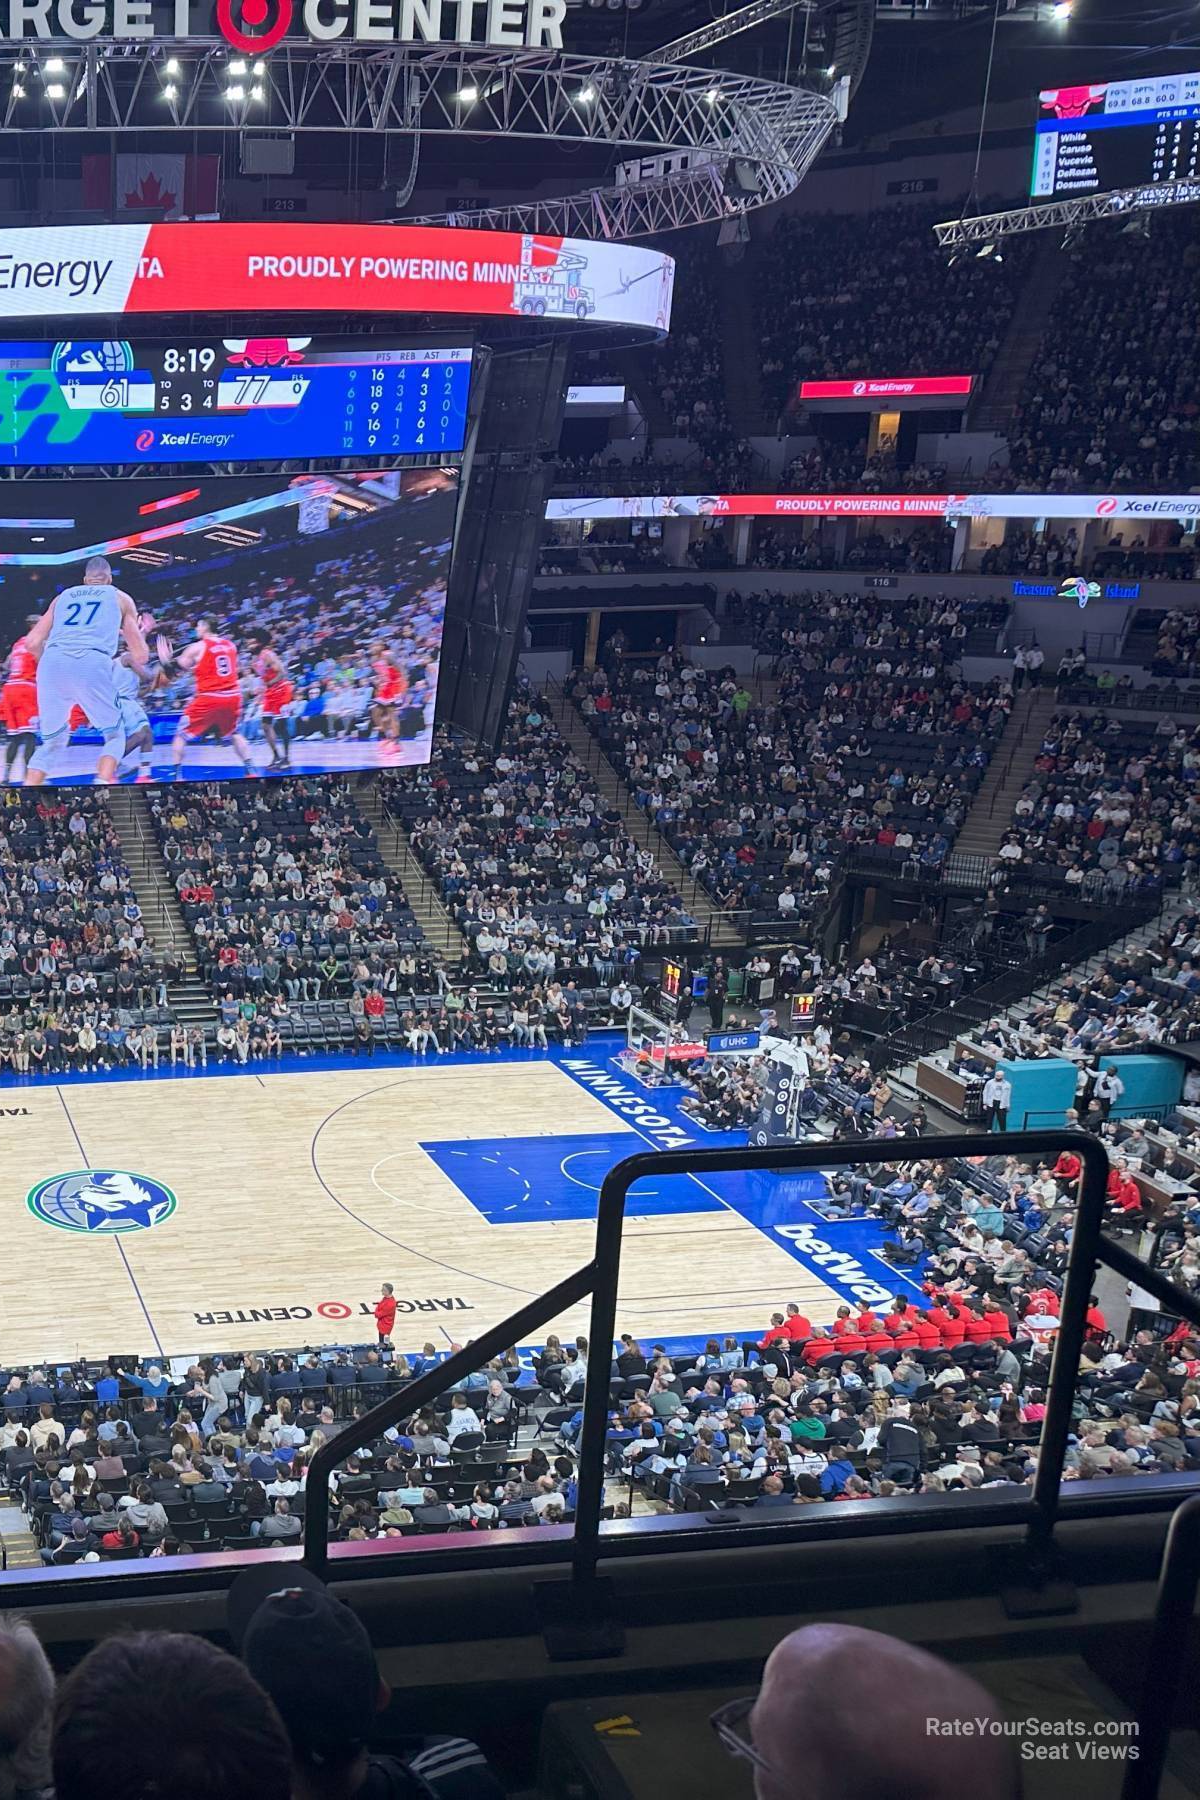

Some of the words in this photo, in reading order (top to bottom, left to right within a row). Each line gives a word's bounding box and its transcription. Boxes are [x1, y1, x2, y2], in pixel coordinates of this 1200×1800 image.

[304, 0, 566, 49] CENTER
[1175, 121, 1181, 130] 4
[1059, 144, 1092, 154] Caruso
[1174, 133, 1180, 142] 3
[1193, 132, 1199, 140] 3
[1172, 145, 1178, 155] 4
[1191, 144, 1198, 153] 4
[1057, 168, 1097, 178] DeRozan
[1190, 156, 1196, 165] 6
[1056, 179, 1099, 190] Dosunmu
[1169, 170, 1176, 179] 2
[248, 256, 356, 278] PROUDLY
[360, 257, 468, 281] POWERING
[163, 348, 215, 373] 8:19
[376, 353, 391, 361] PTS
[400, 352, 415, 360] REB
[424, 351, 440, 360] AST
[451, 350, 461, 359] PF
[349, 370, 357, 381] 9
[372, 369, 384, 381] 16
[398, 368, 405, 379] 4
[422, 367, 430, 379] 4
[445, 366, 453, 378] 0
[160, 381, 171, 389] TO
[203, 380, 214, 388] TO
[234, 375, 271, 405] 77
[347, 388, 355, 399] 6
[371, 385, 383, 398] 18
[396, 385, 404, 397] 3
[420, 384, 428, 396] 3
[444, 383, 452, 395] 2
[868, 384, 888, 392] Xcel
[100, 378, 129, 408] 61
[160, 396, 169, 410] 5
[181, 394, 192, 411] 3
[202, 395, 212, 408] 4
[346, 404, 354, 415] 0
[371, 402, 379, 414] 9
[395, 401, 402, 413] 4
[419, 400, 426, 412] 3
[442, 399, 451, 411] 0
[345, 421, 352, 432] 11
[368, 419, 381, 431] 16
[417, 417, 425, 429] 6
[440, 416, 449, 427] 0
[160, 433, 190, 445] Xcel
[190, 433, 230, 447] Energy
[343, 437, 353, 448] 12
[368, 435, 376, 447] 9
[392, 434, 400, 446] 2
[416, 433, 424, 445] 4
[776, 500, 831, 511] PROUDLY
[833, 500, 901, 511] POWERING
[1123, 501, 1158, 512] Xcel
[873, 578, 889, 586] 116
[1012, 581, 1056, 597] Treasure
[1106, 583, 1141, 598] Island
[64, 601, 101, 626] 27
[729, 1037, 748, 1046] UHC
[560, 1059, 696, 1149] MINNESOTA
[359, 1297, 474, 1316] TARGT
[194, 1306, 313, 1326] CENTER
